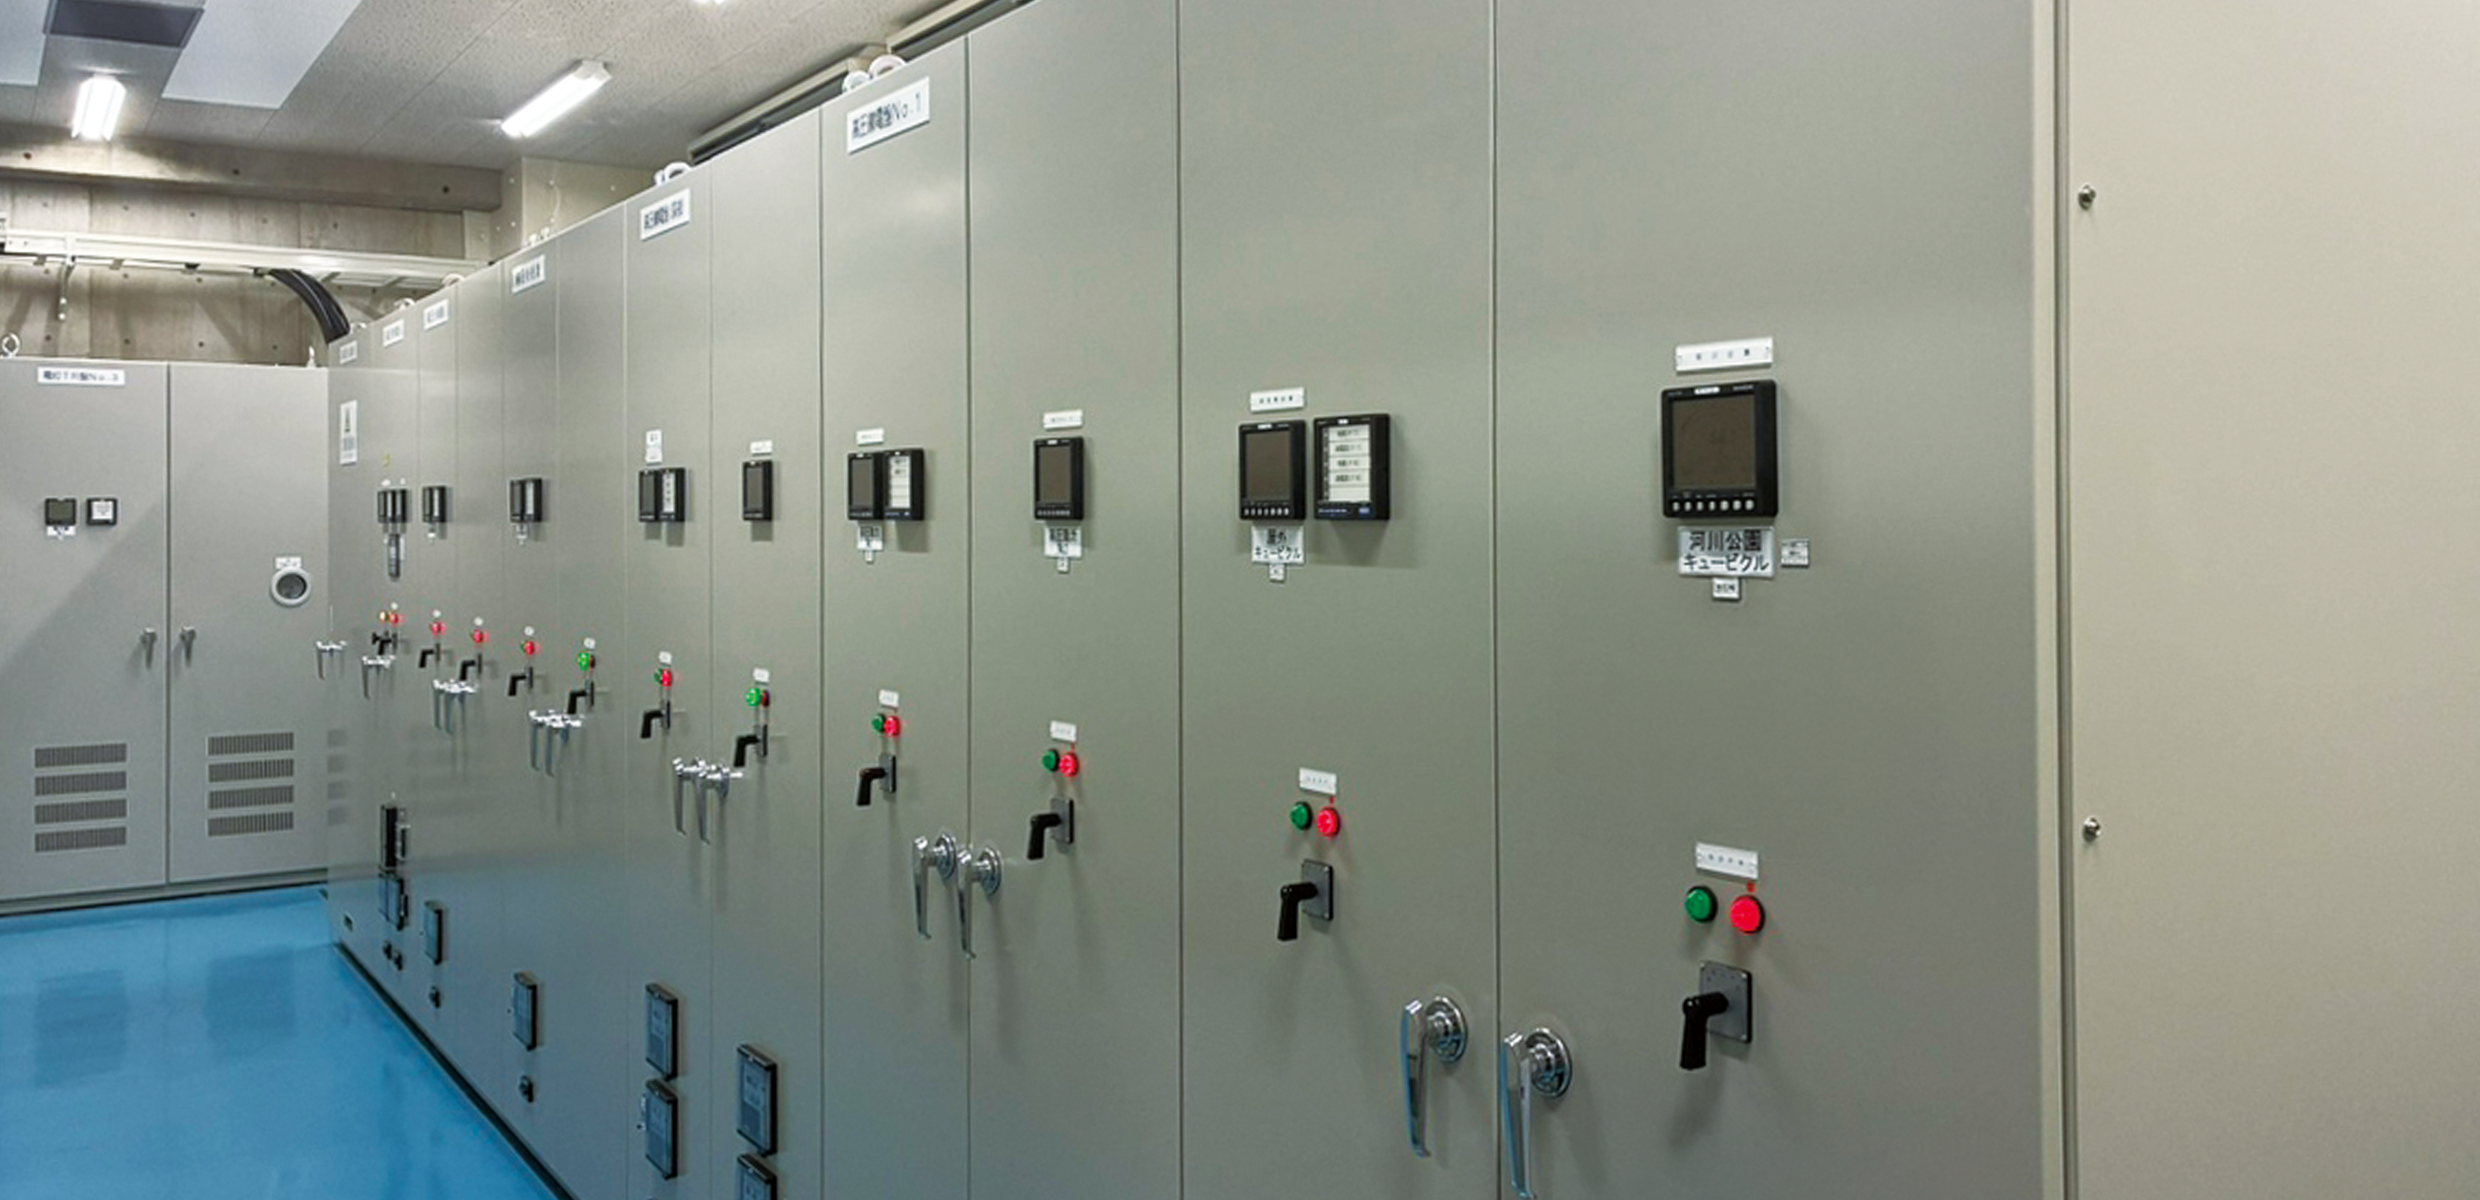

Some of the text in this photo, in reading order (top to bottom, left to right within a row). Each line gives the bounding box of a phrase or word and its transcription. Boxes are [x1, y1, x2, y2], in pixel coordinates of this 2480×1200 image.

[1689, 529, 1762, 552] 河川公園
[1255, 545, 1301, 560] キュービクル
[1683, 552, 1770, 572] キュービクル
